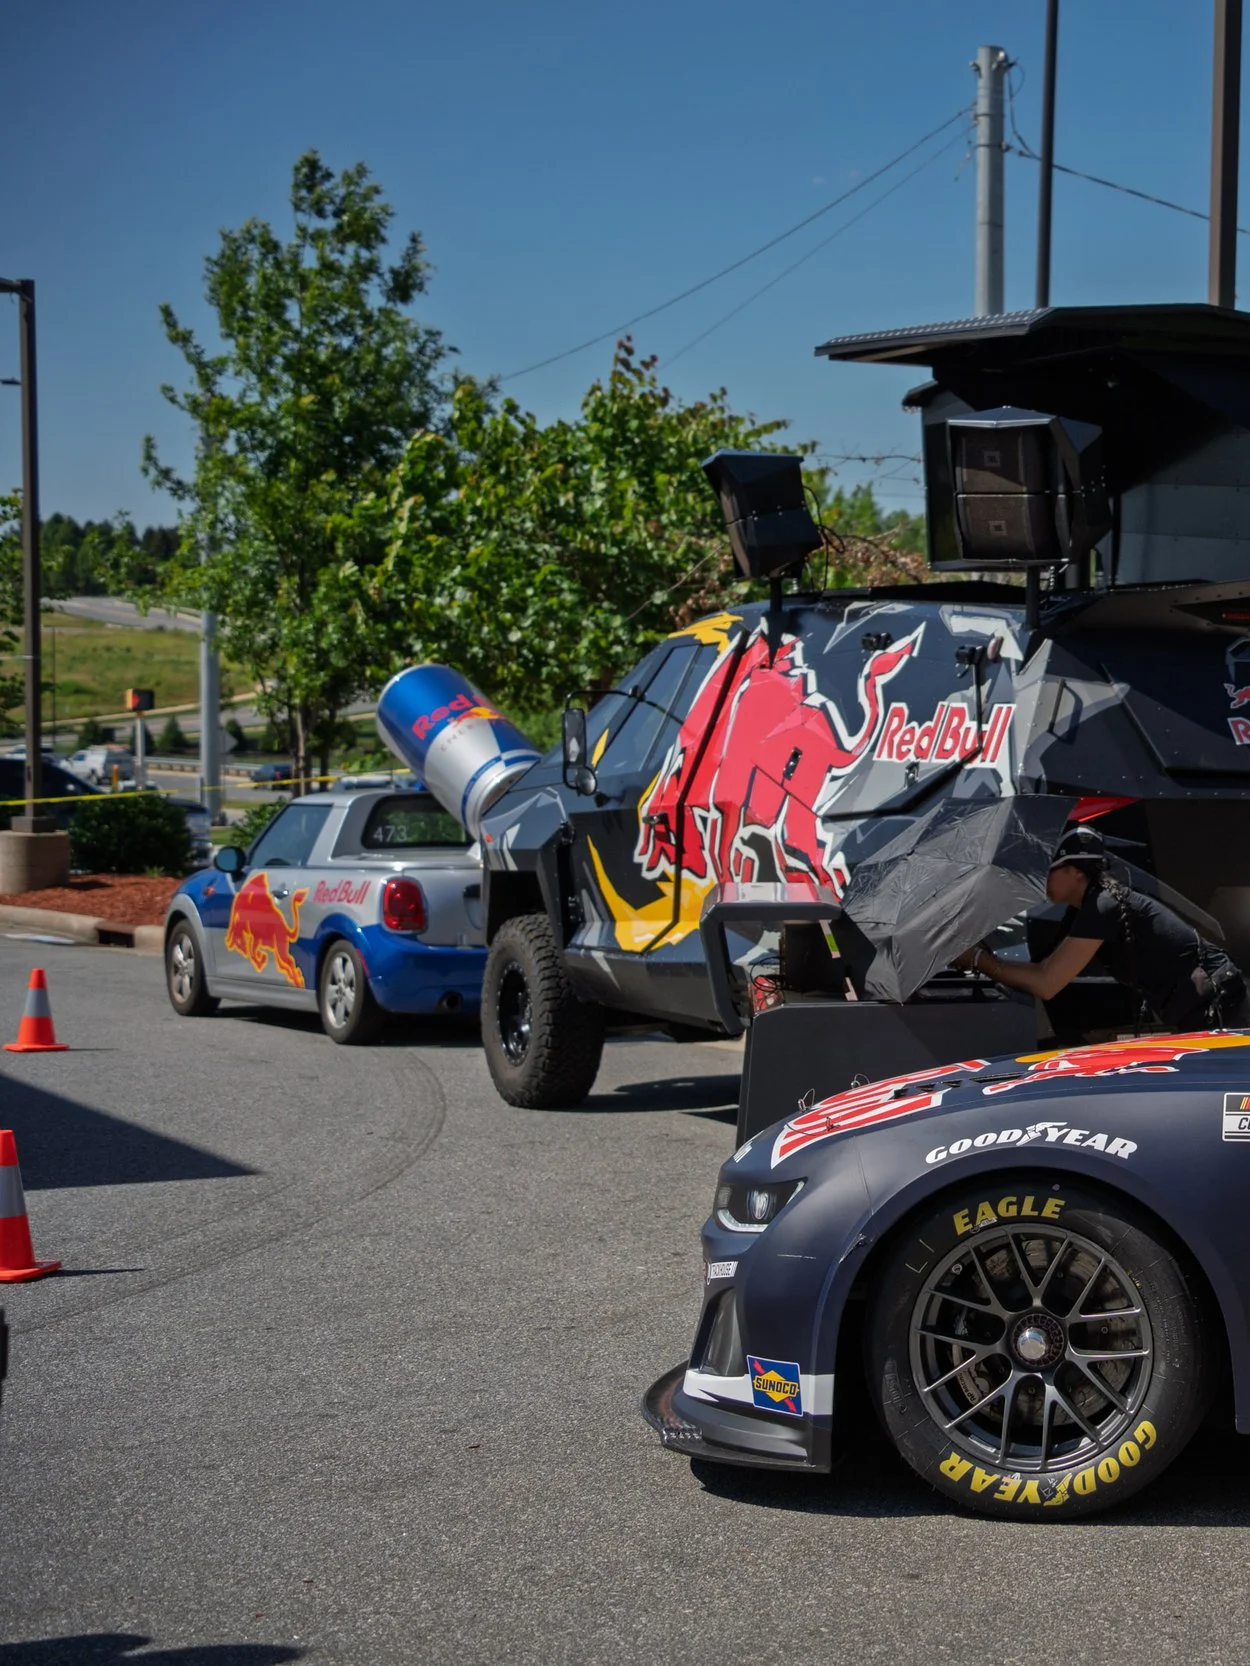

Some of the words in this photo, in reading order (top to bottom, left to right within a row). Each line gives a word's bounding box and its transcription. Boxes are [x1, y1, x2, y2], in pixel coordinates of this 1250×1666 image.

[873, 702, 948, 762] Red
[373, 826, 407, 842] 473
[314, 880, 343, 904] Red
[337, 880, 371, 905] Bull
[952, 1196, 1066, 1236] EAGLE
[755, 1377, 798, 1396] SUNOCO
